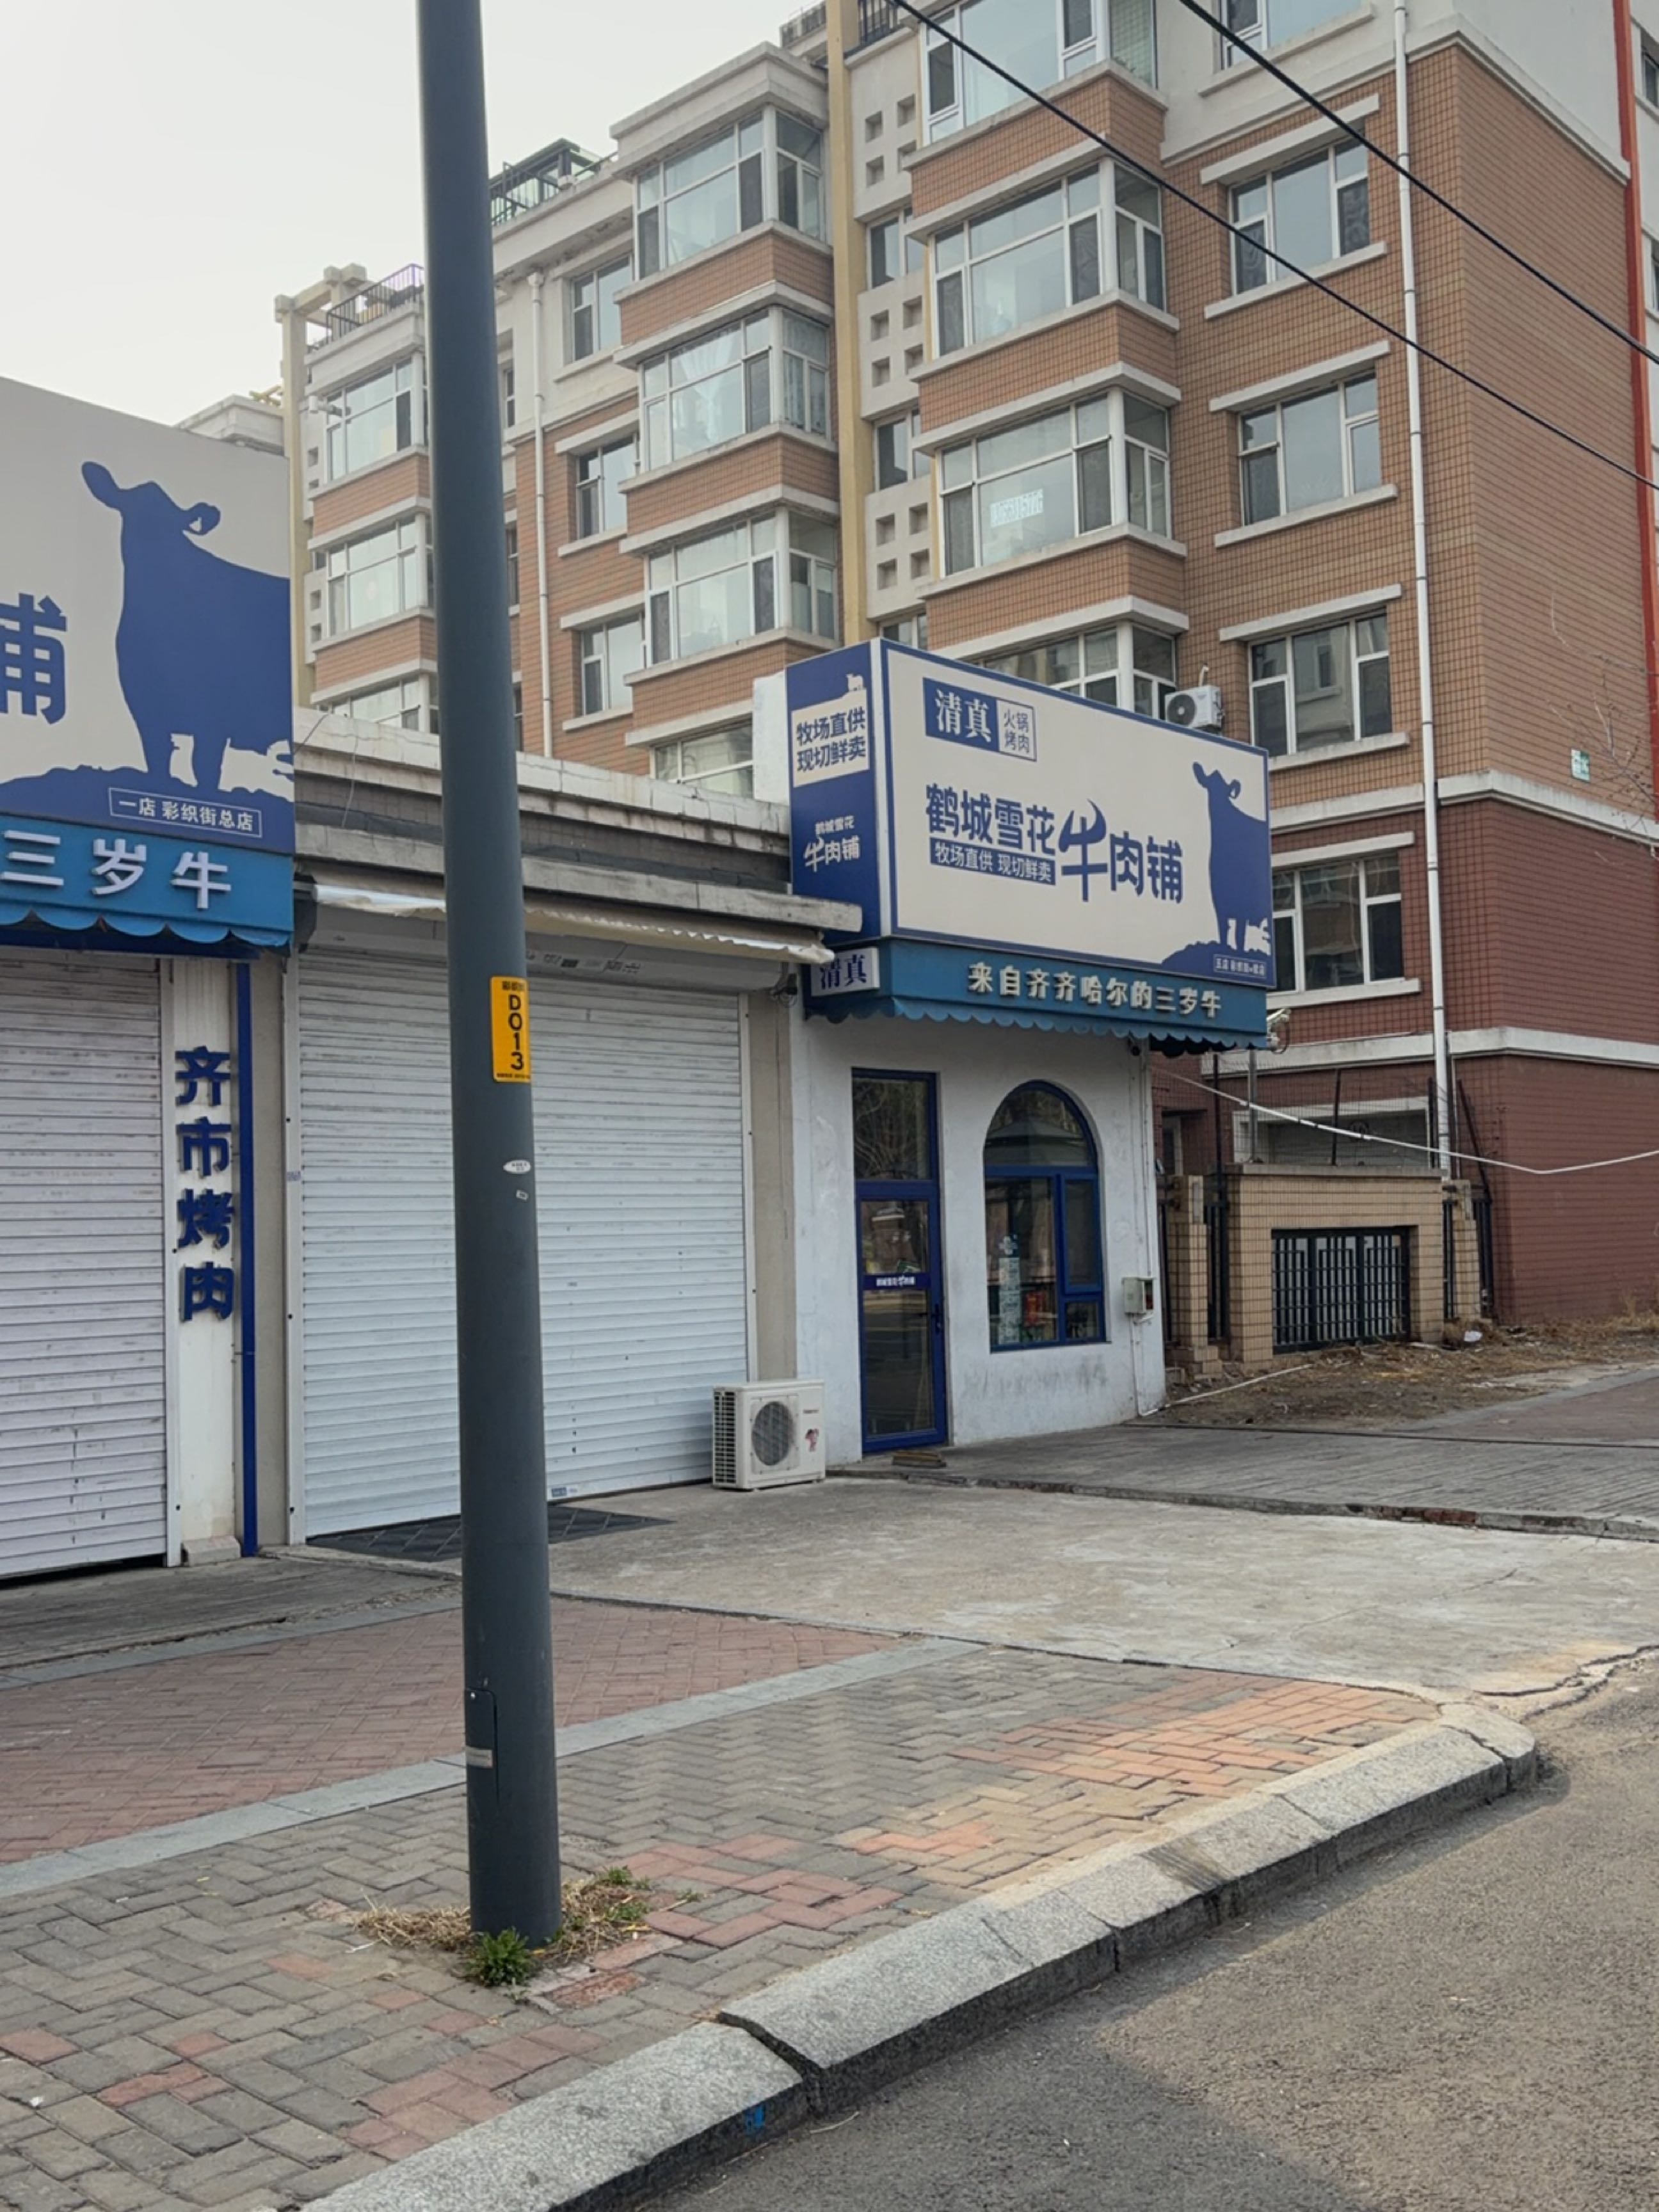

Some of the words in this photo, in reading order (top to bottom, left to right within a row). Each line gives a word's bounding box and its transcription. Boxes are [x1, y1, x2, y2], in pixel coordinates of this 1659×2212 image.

[796, 706, 865, 746] 牧场直供
[935, 687, 991, 742] 清真
[1004, 709, 1029, 733] 火锅
[797, 735, 865, 772] 现切鲜卖
[1005, 730, 1030, 753] 烤肉
[118, 797, 156, 817] 一店
[161, 801, 253, 831] 彩织街总店
[803, 835, 860, 872] 牛肉铺
[926, 783, 1183, 904] 鹤城雪花牛肉铺
[934, 841, 993, 872] 牧场直供
[998, 854, 1052, 883] 现切鲜卖
[0, 830, 232, 910] 三岁牛
[820, 954, 867, 990] 清真
[968, 961, 1221, 1018] 来自齐齐哈尔的三岁牛
[508, 995, 524, 1070] D013
[175, 1046, 235, 1322] 齐市烤肉
